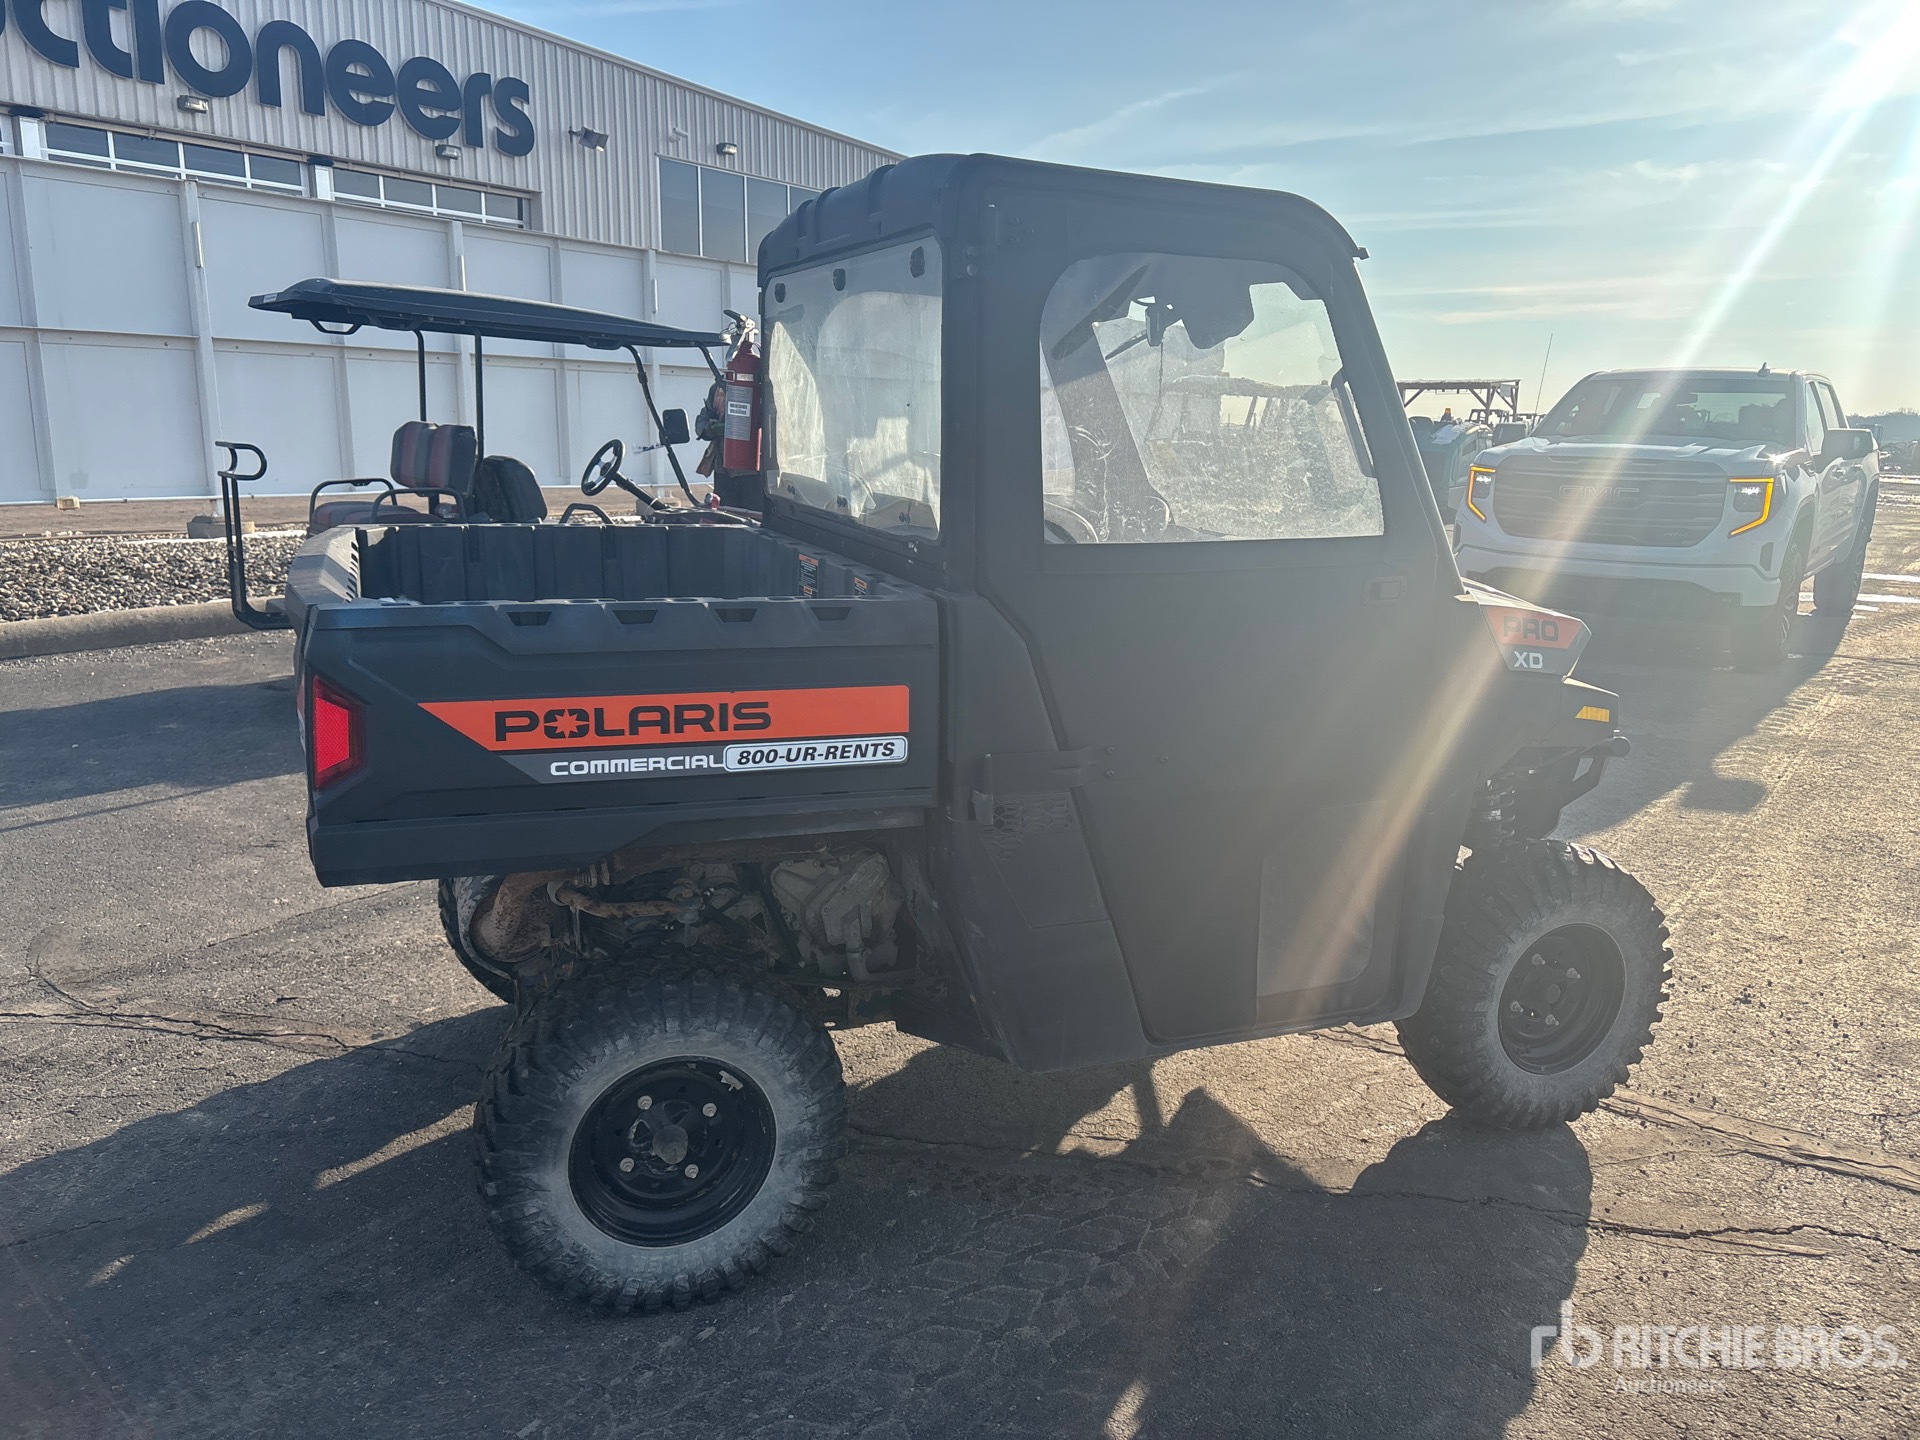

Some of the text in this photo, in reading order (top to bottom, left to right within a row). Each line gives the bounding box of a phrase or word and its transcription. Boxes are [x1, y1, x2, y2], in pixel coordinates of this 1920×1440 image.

[0, 0, 535, 157] ctioneers
[1558, 484, 1640, 502] GMC
[1503, 615, 1559, 642] PRO
[1514, 650, 1544, 669] XD
[494, 701, 772, 742] POLARIS
[550, 754, 724, 776] COMMERCIAL
[736, 741, 896, 766] 800-UR-RENTS
